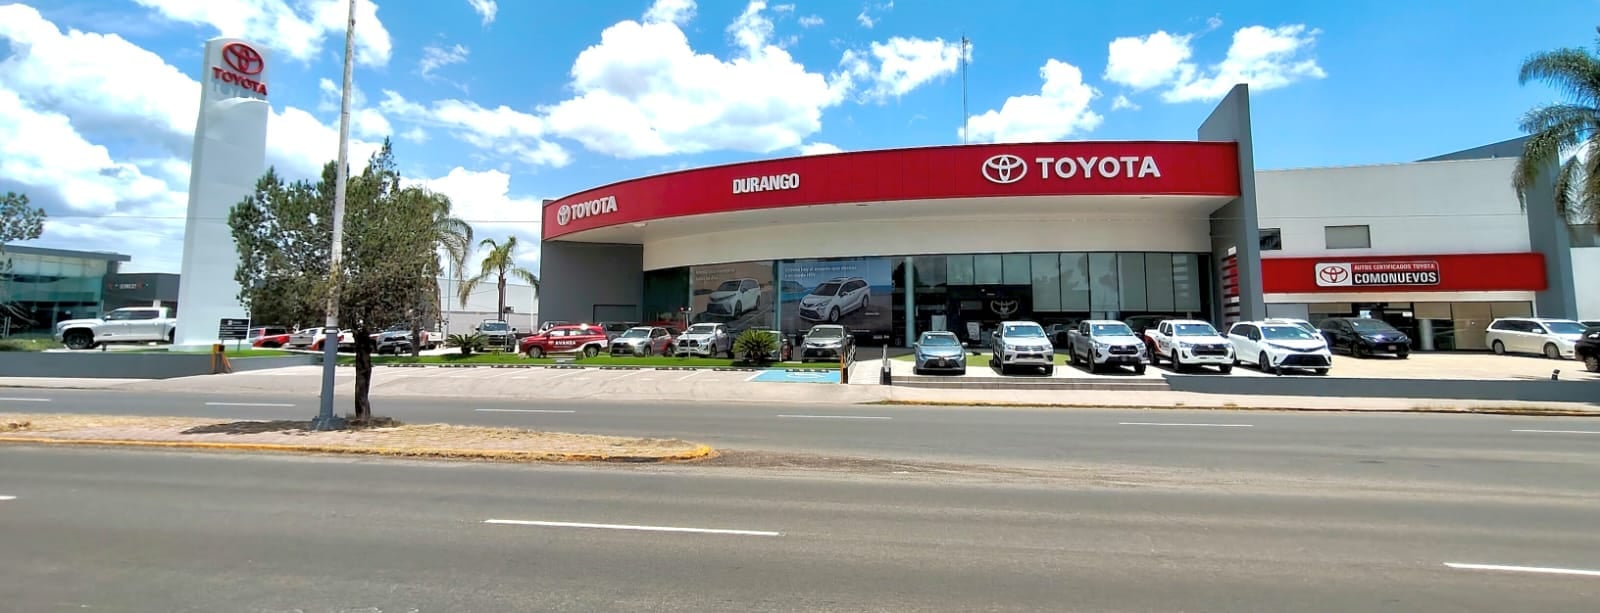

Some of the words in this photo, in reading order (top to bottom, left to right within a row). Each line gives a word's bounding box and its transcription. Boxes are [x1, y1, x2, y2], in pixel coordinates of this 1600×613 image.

[212, 66, 267, 96] TOYOTA
[1036, 156, 1161, 179] TOYOTA
[732, 173, 800, 194] DURANGO
[571, 195, 618, 220] TOYOTA
[1354, 272, 1437, 284] COMONUEVOS
